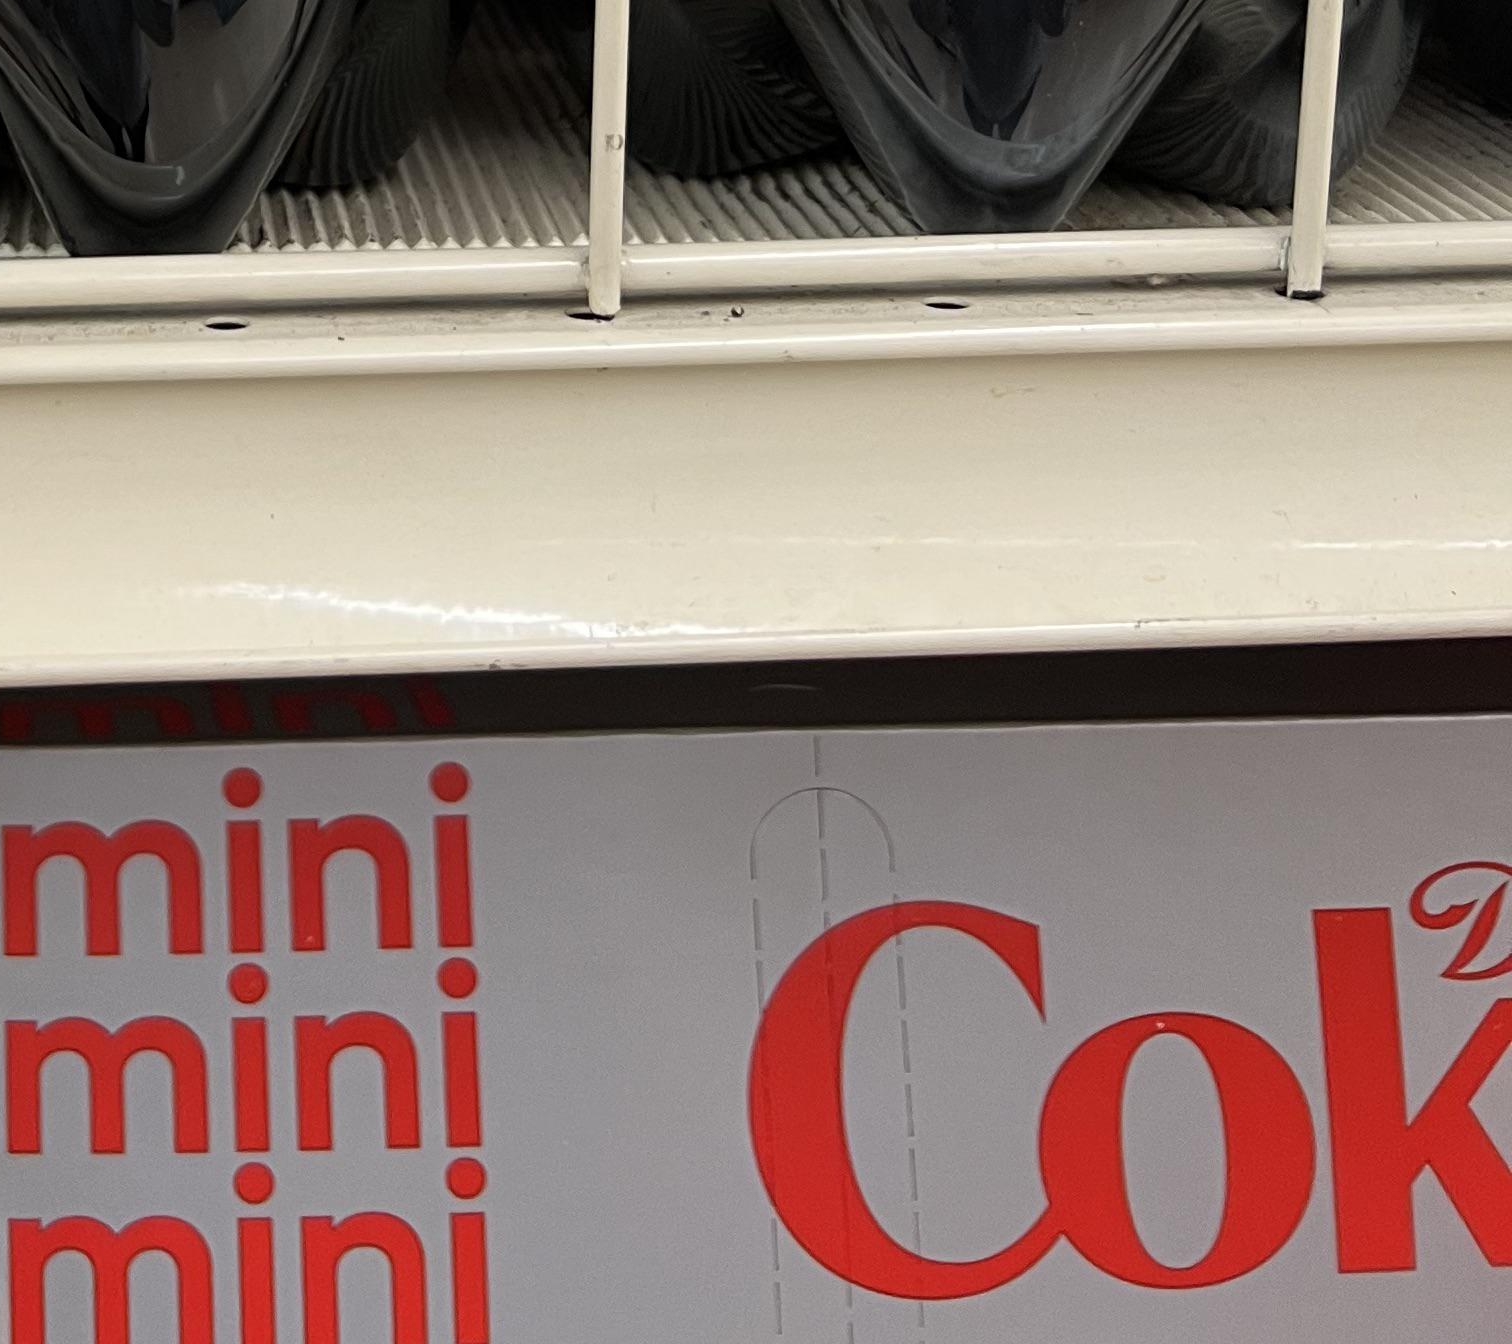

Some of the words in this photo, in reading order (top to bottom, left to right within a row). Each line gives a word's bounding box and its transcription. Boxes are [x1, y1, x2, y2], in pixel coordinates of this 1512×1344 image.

[0, 760, 474, 957] mini
[3, 956, 483, 1155] mini
[7, 1157, 491, 1344] mini
